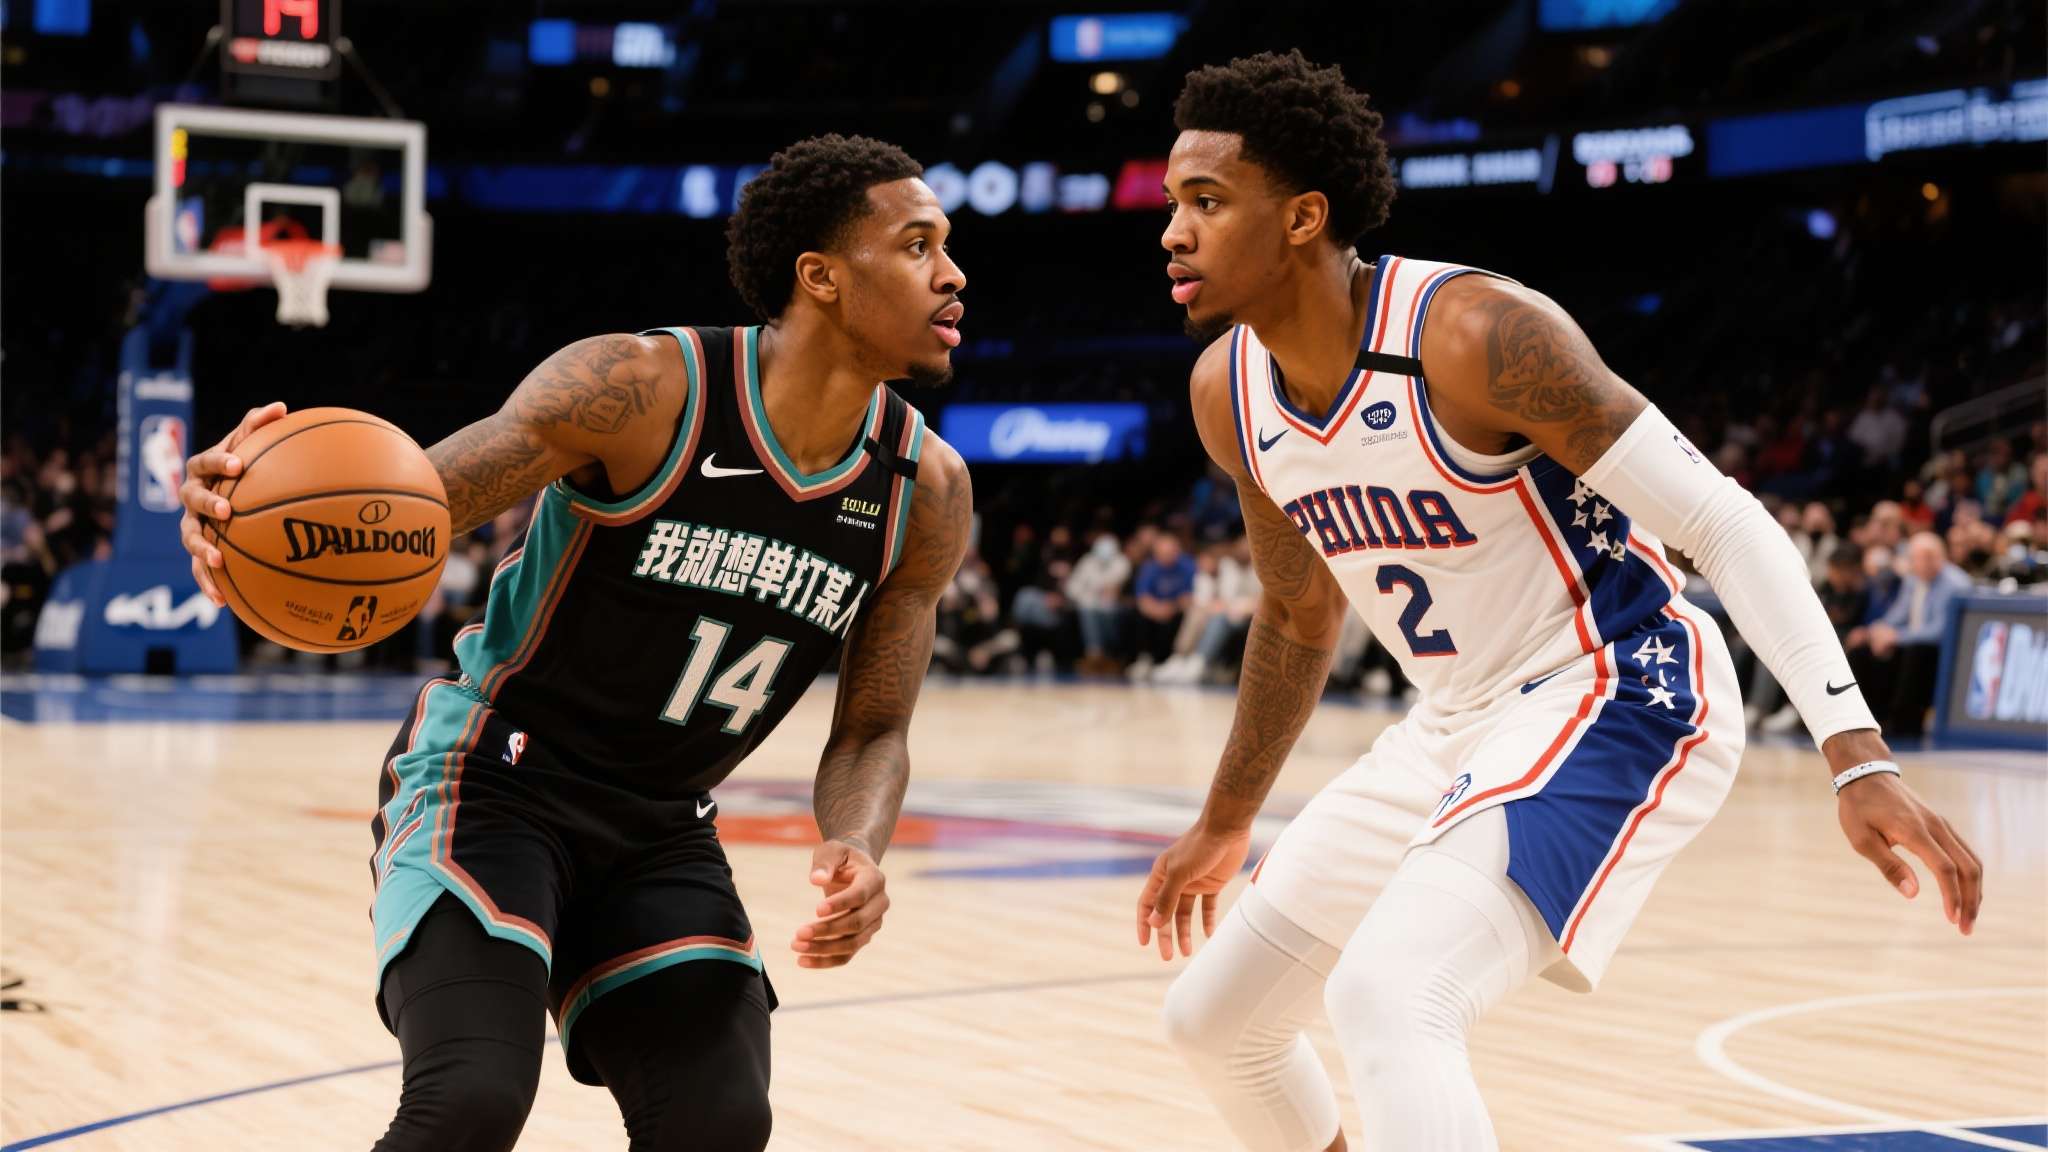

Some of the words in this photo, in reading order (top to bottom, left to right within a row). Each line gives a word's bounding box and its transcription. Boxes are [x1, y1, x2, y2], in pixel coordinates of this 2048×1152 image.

[632, 518, 869, 640] 我就想单打某人
[1375, 564, 1458, 657] 2
[658, 615, 795, 736] 14
